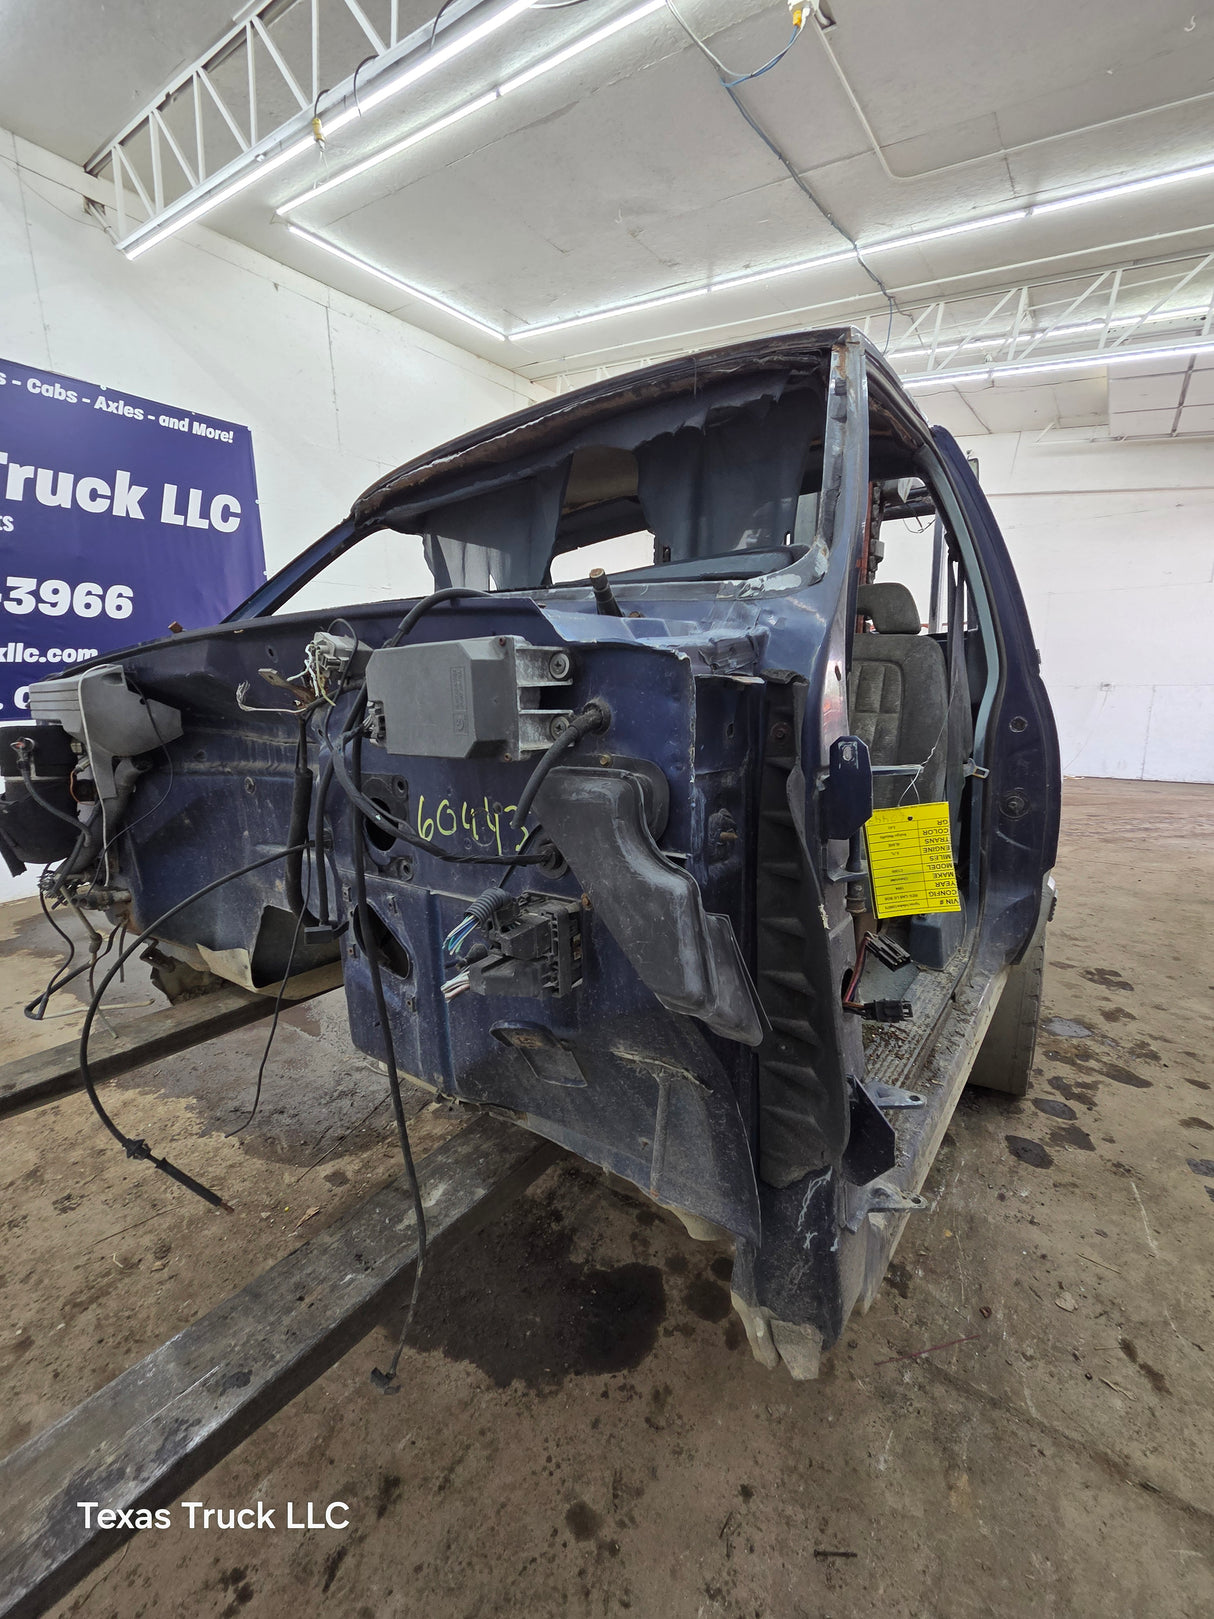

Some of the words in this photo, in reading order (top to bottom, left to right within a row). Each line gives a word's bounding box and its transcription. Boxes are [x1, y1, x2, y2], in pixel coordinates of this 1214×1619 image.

[26, 378, 78, 404] Cabs
[94, 396, 144, 421] Axles
[159, 412, 189, 433] and
[192, 421, 234, 444] More!
[0, 452, 148, 520] ruck
[160, 483, 242, 533] LLC
[922, 828, 949, 836] COLOR
[922, 845, 951, 853] ENGINE
[929, 853, 952, 861] MILES
[928, 890, 957, 898] CONFIG
